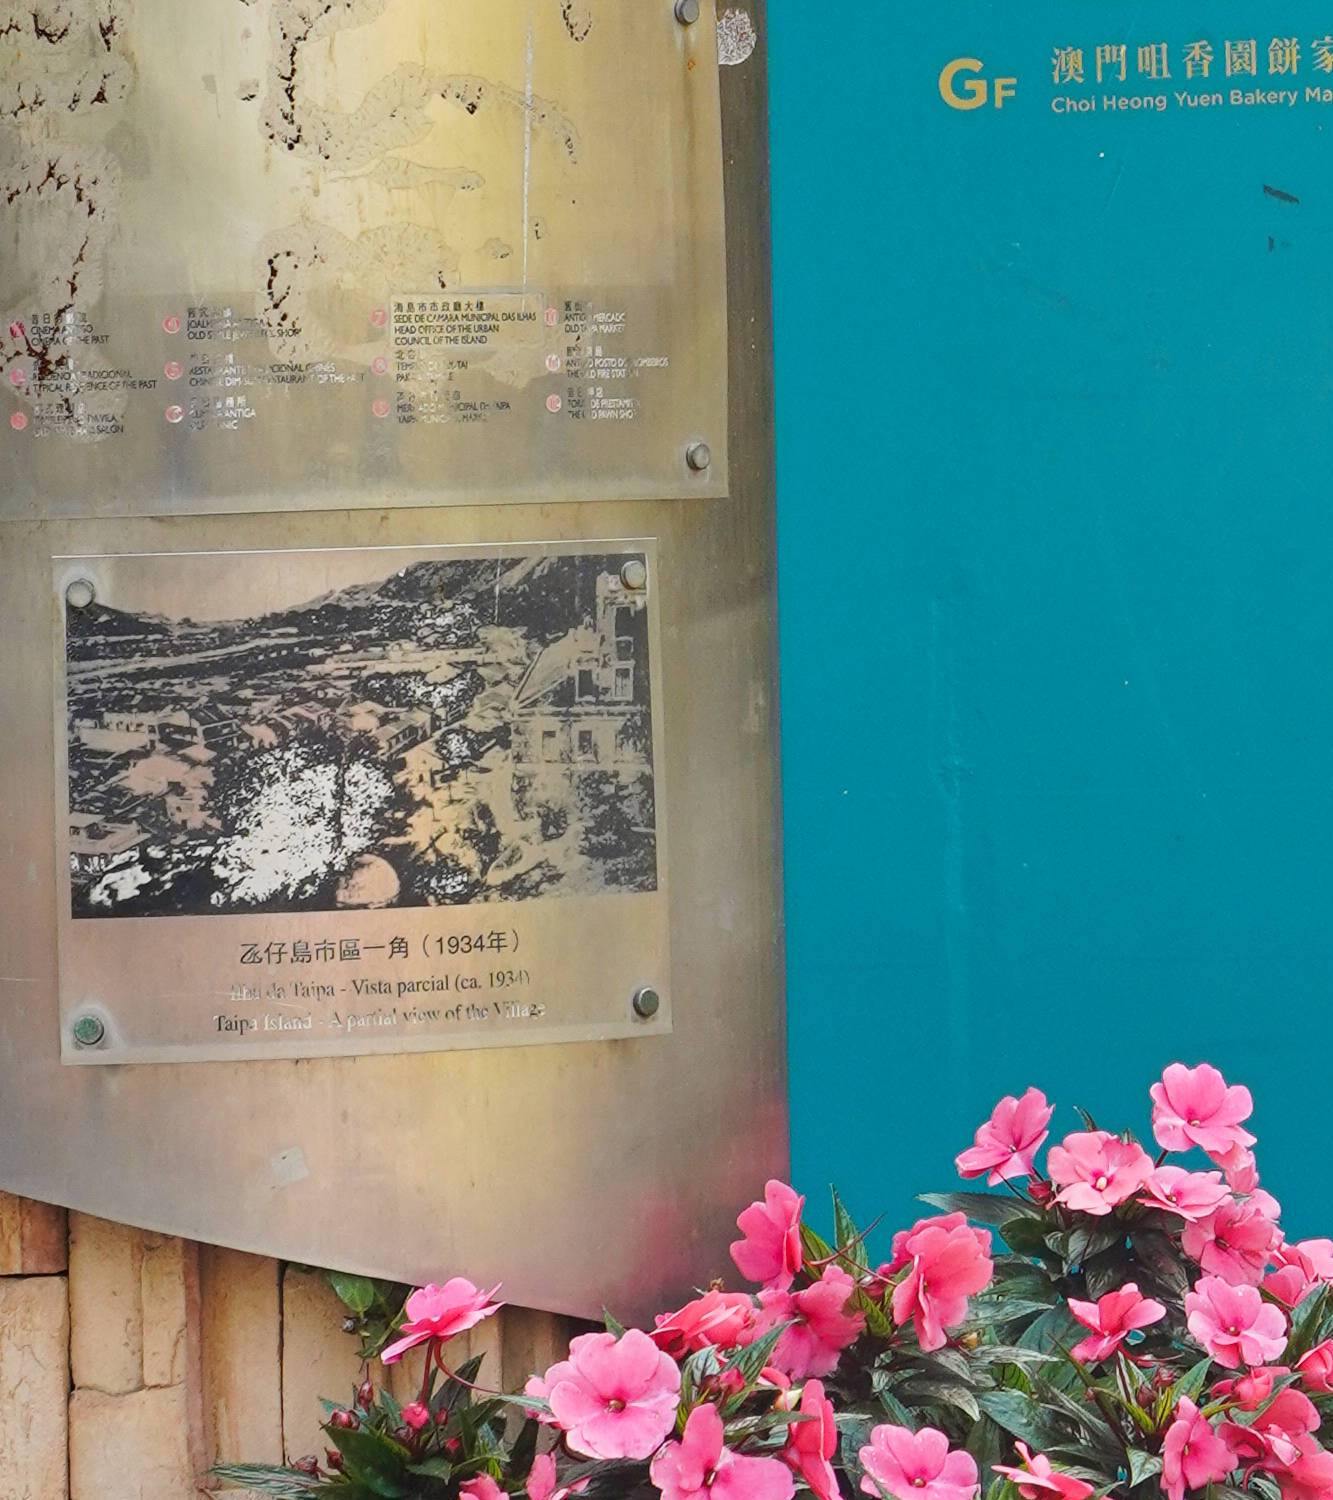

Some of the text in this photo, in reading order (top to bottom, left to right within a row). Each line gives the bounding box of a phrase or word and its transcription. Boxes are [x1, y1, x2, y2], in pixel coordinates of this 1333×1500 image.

[938, 57, 1017, 111] GF
[1051, 96, 1096, 113] Choi
[1102, 93, 1167, 112] Heong
[1174, 89, 1223, 107] Yuen
[1229, 87, 1298, 107] Bakery
[394, 325, 417, 335] HEAD
[457, 324, 473, 334] THE
[444, 335, 460, 345] THE
[290, 980, 335, 1001] Taipa
[352, 978, 392, 996] Vista
[397, 975, 449, 998] parcial
[454, 974, 482, 993] (ca.
[213, 1014, 258, 1035] Taipa
[263, 1012, 313, 1031] Island
[328, 1012, 344, 1029] A
[346, 1007, 398, 1033] partial
[401, 1007, 441, 1023] view
[445, 1004, 463, 1020] of
[465, 1003, 489, 1020] the
